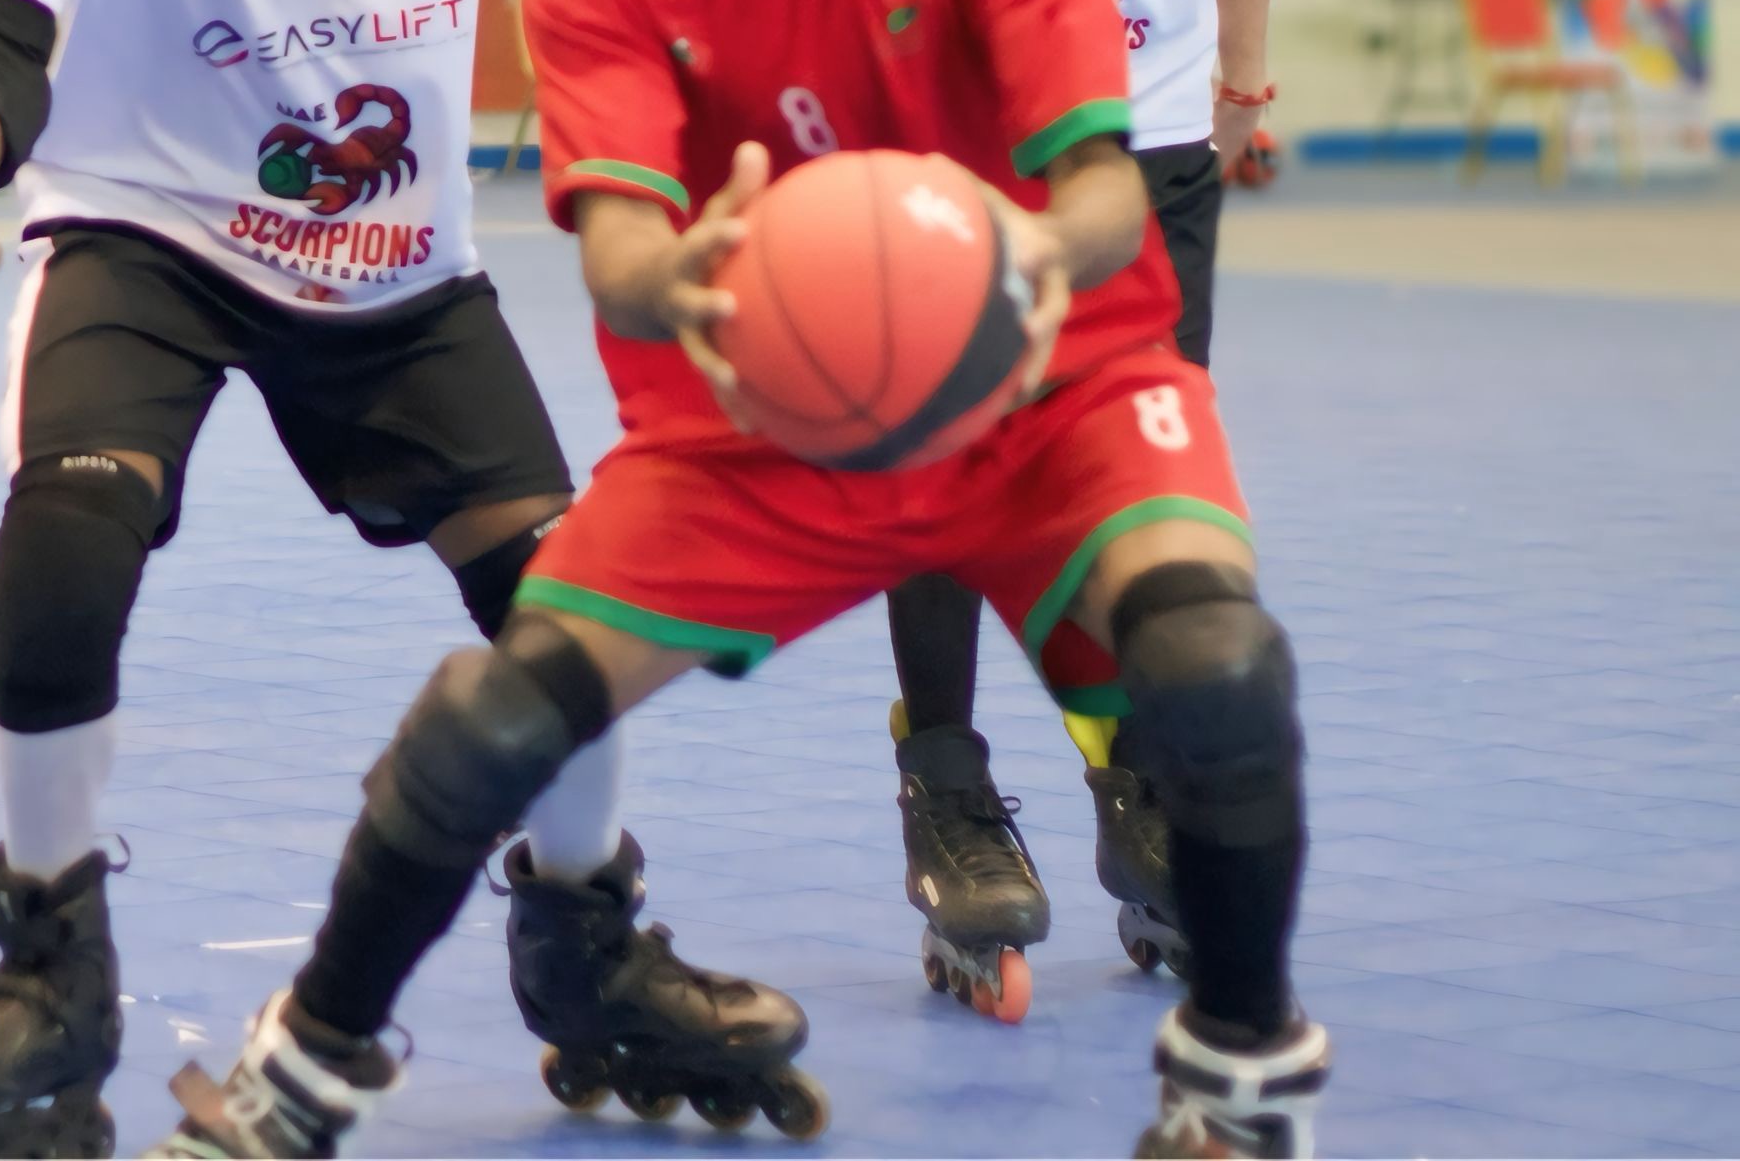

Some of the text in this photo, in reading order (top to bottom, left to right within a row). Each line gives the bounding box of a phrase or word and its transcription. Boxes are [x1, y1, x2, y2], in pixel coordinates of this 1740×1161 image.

[276, 101, 327, 123] UAE
[777, 86, 840, 157] 8
[229, 203, 435, 269] SCORPIONS
[1132, 384, 1190, 452] 8
